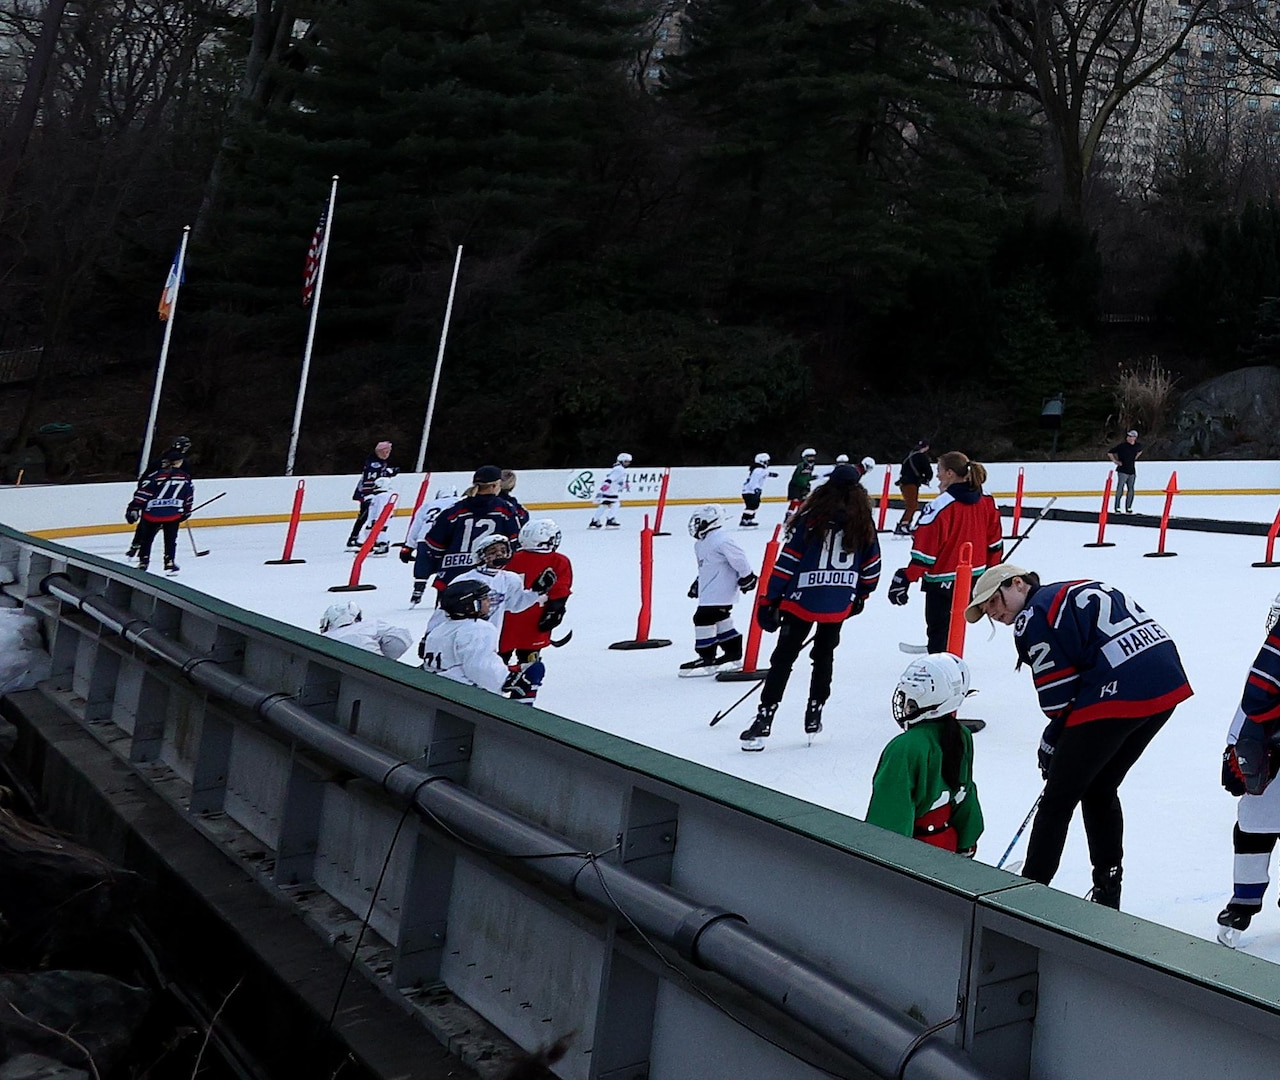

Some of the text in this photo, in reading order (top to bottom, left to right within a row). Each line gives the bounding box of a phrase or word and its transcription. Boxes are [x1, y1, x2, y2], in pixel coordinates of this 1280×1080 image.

[460, 519, 496, 553] 12
[818, 529, 855, 570] 16
[444, 554, 473, 567] BERG
[1116, 624, 1167, 657] HARLE
